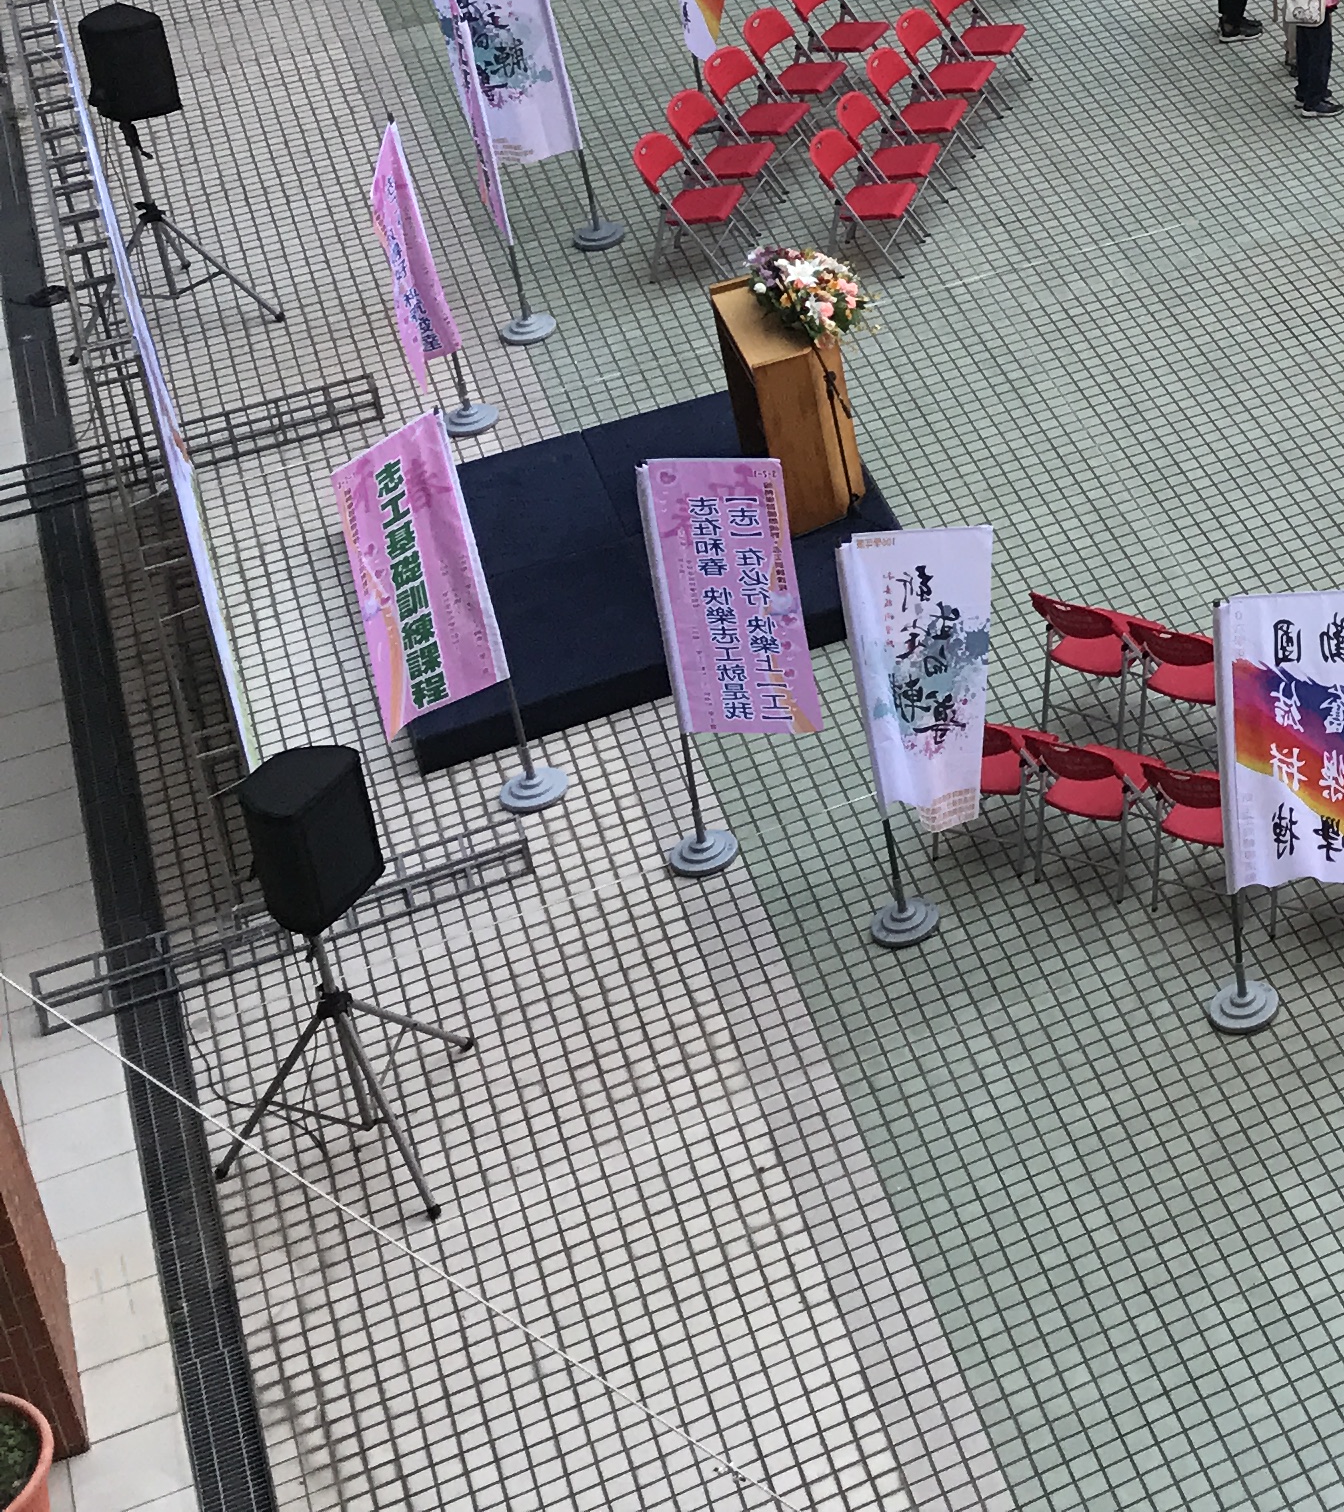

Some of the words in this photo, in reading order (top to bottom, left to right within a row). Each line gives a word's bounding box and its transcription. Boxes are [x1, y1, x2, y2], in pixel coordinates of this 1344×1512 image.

[374, 457, 450, 710] 志工基礎訓練課程
